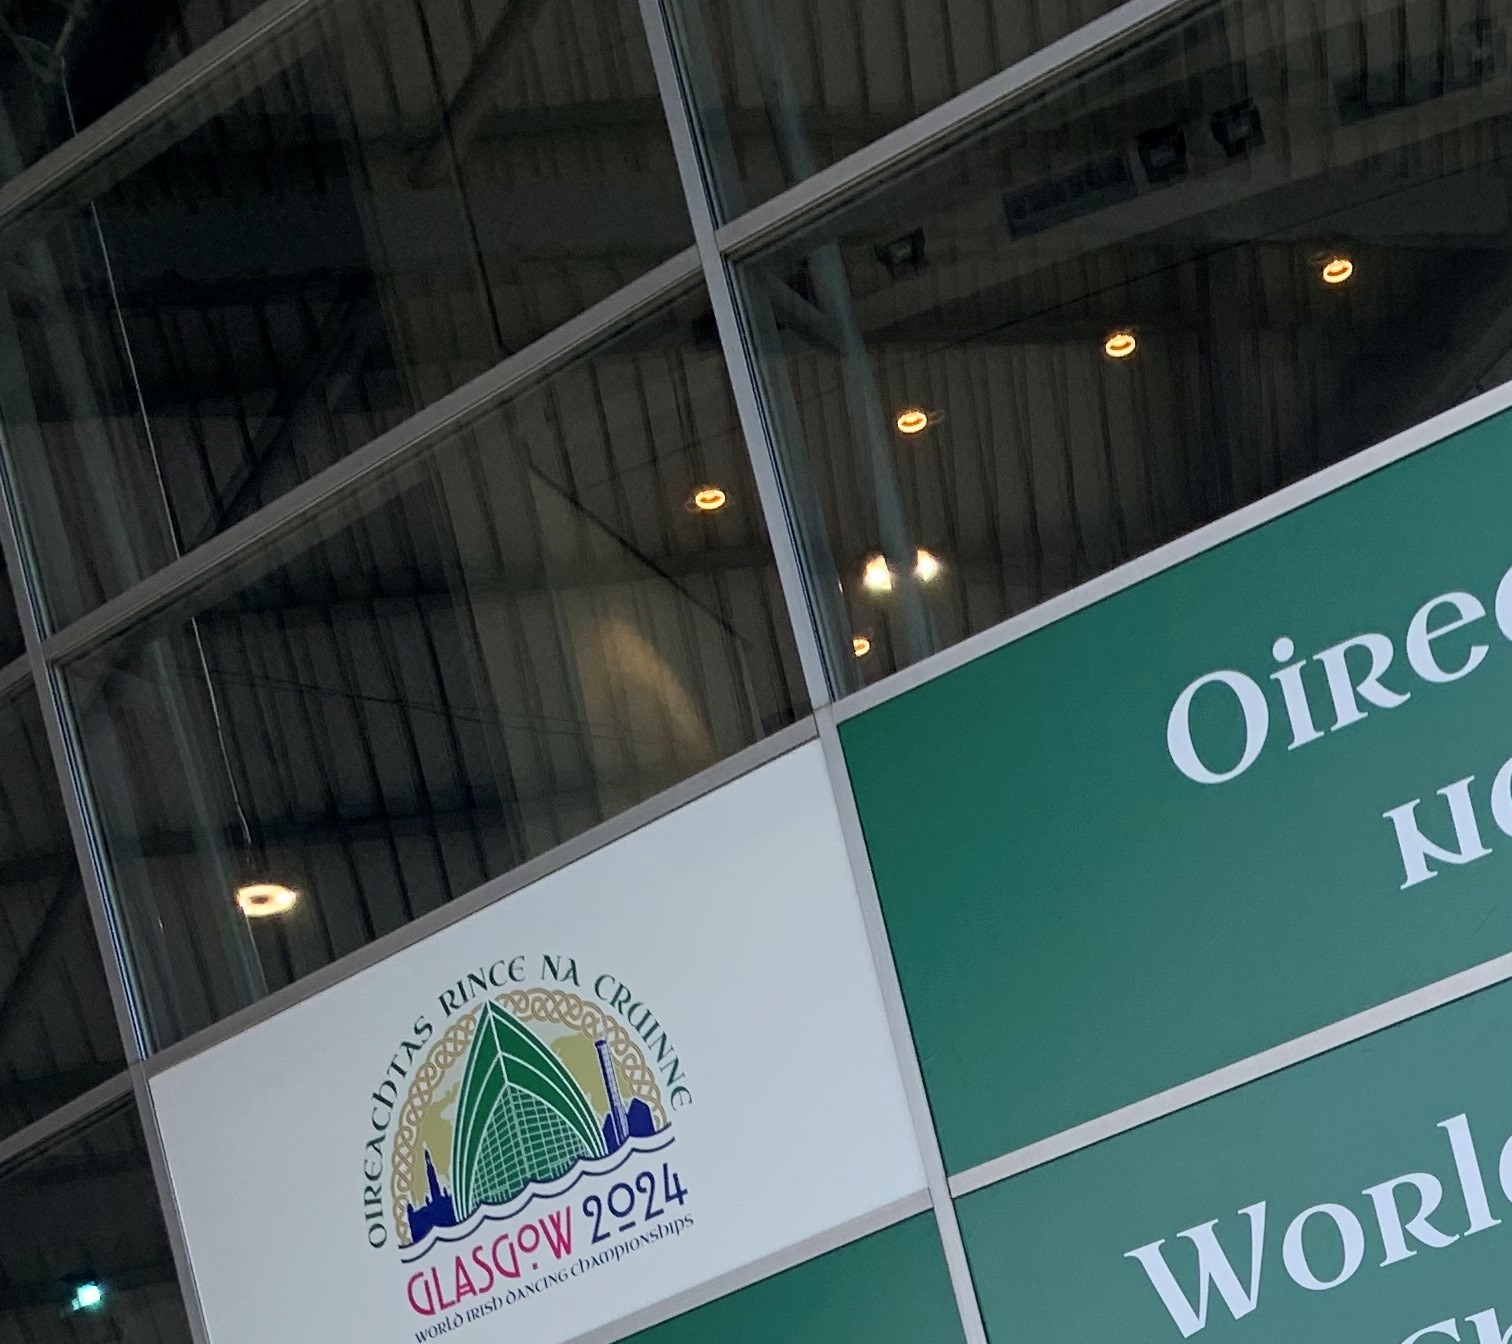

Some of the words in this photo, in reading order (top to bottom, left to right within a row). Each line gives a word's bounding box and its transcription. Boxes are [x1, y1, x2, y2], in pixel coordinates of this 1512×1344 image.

[438, 955, 526, 1018] RINCE
[540, 954, 580, 987] NA
[594, 975, 693, 1111] CRUINNE
[407, 1206, 573, 1316] GLASGOW
[583, 1163, 688, 1246] 2024
